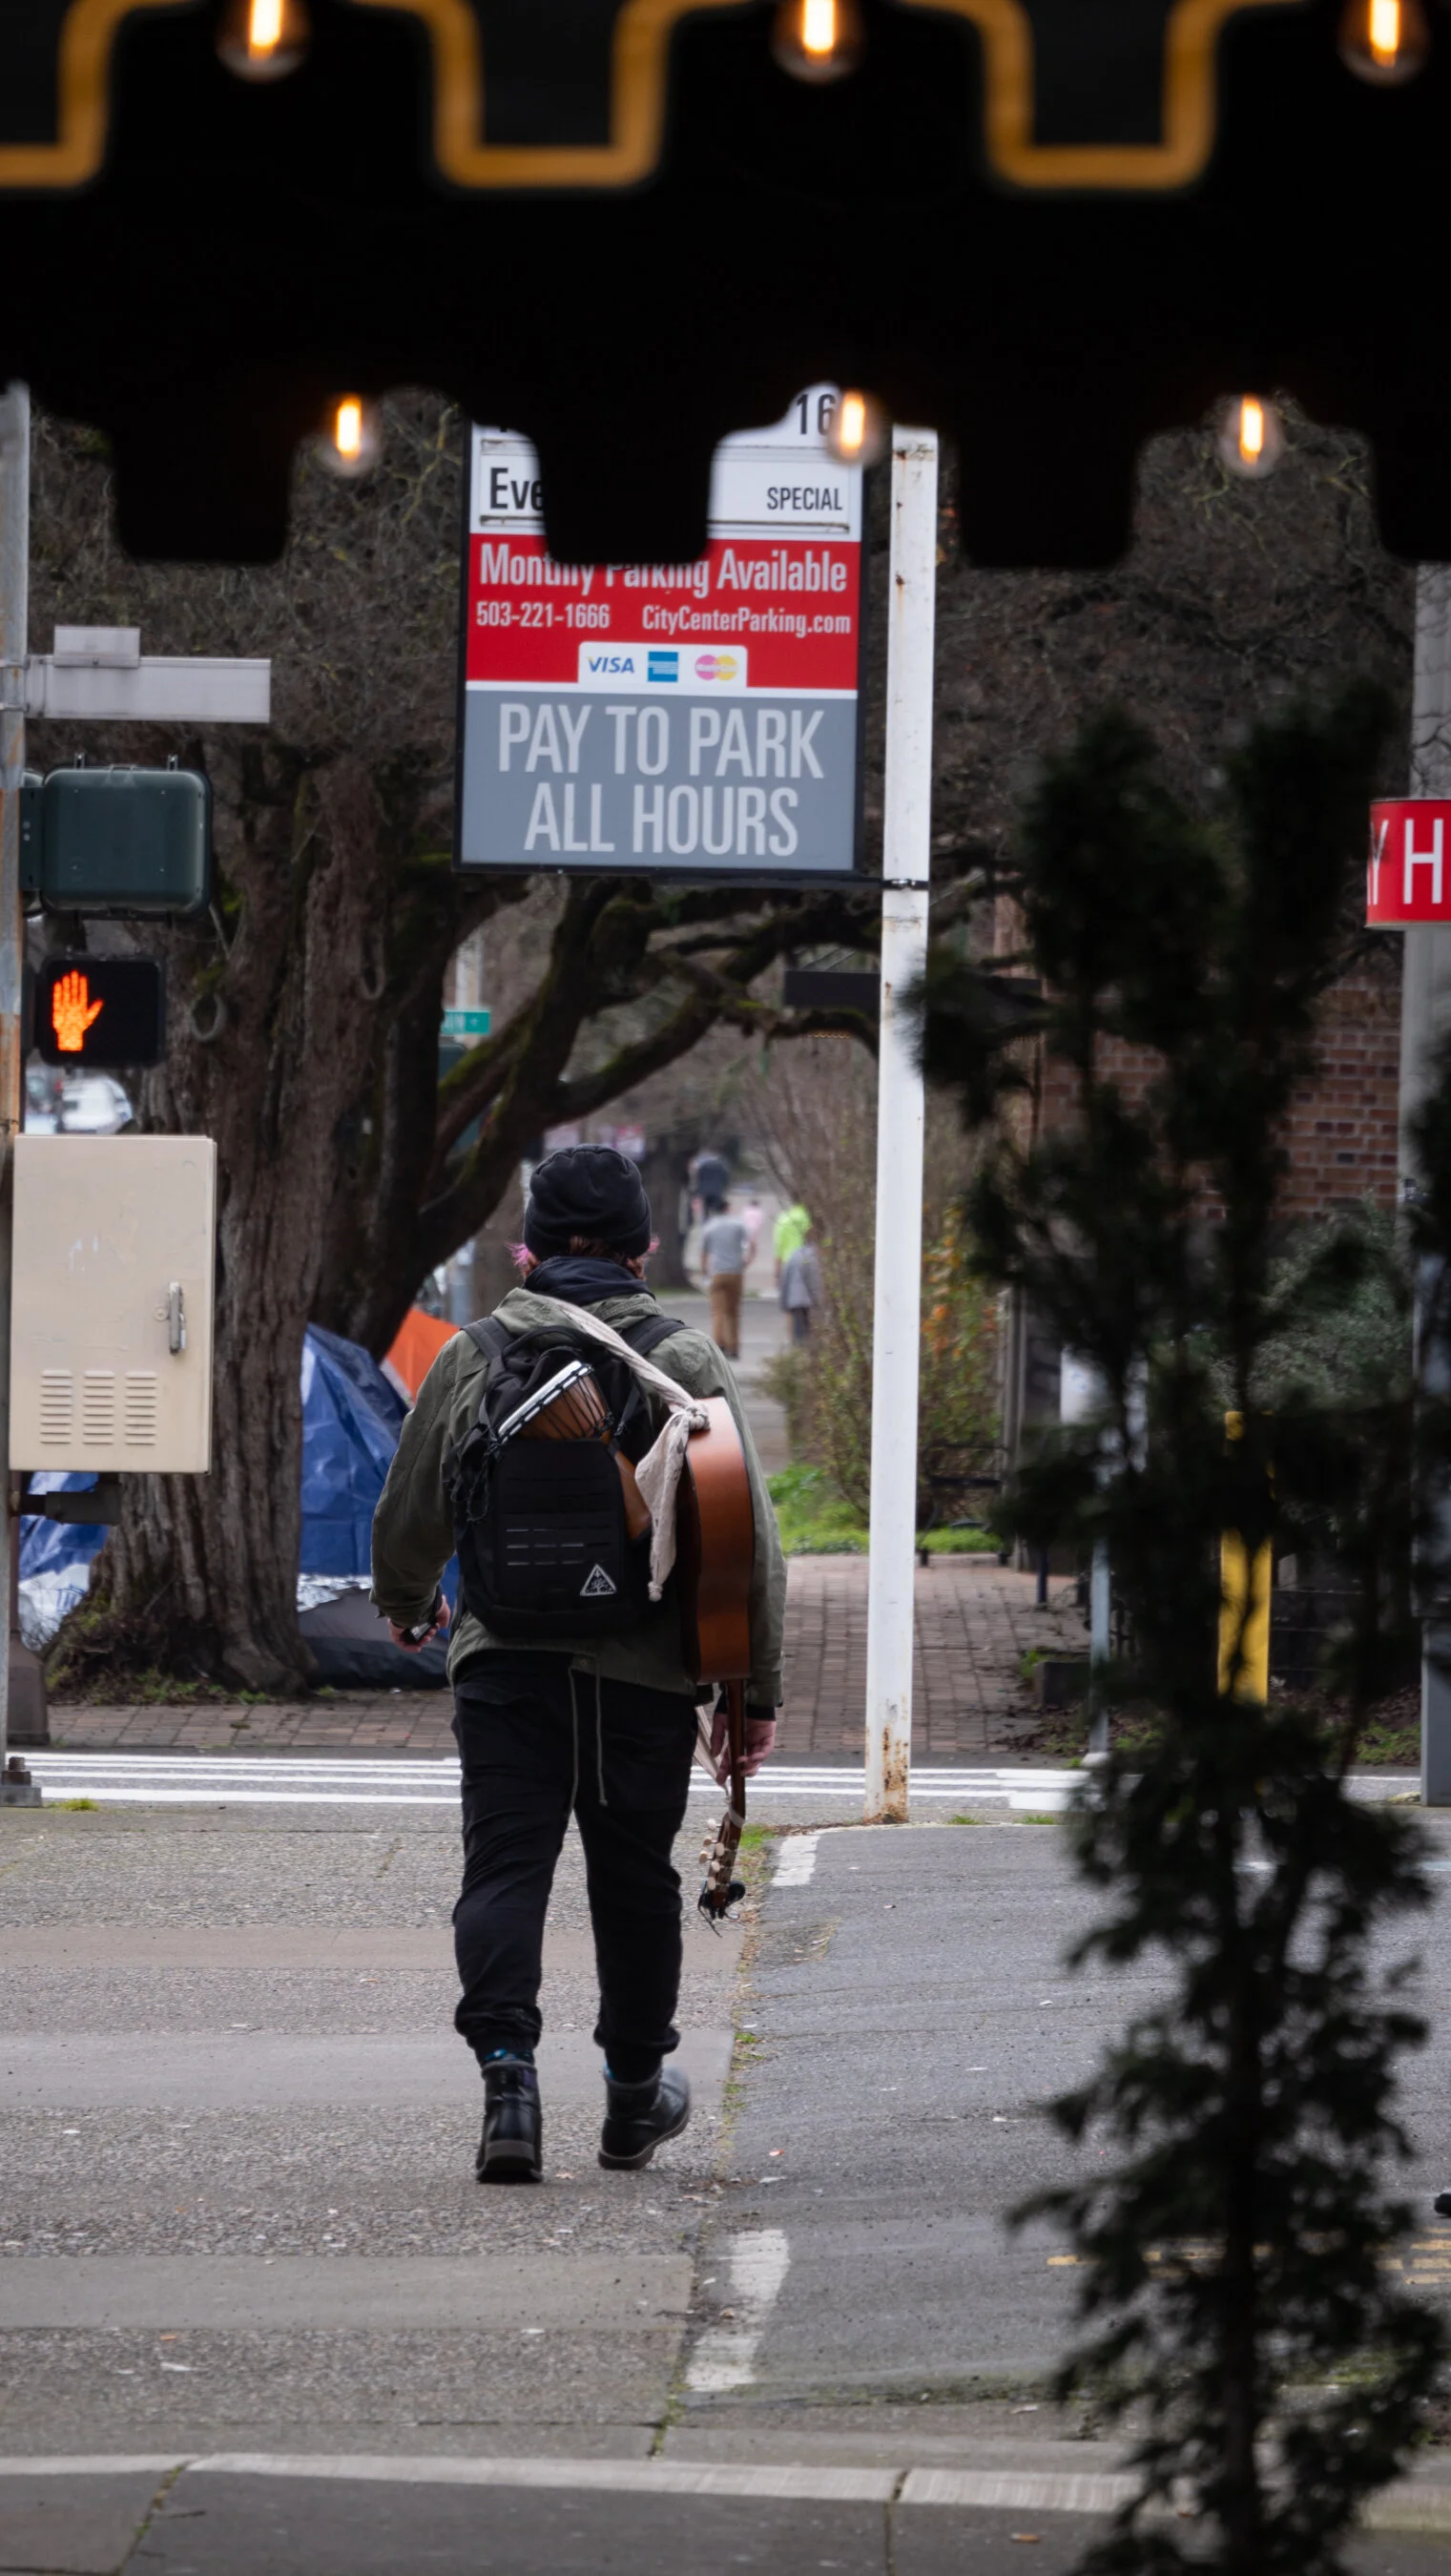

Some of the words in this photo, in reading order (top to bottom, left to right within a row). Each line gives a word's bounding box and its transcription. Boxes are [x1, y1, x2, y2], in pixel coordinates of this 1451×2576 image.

[767, 487, 843, 510] SPECIAL
[716, 549, 847, 592] Available
[477, 600, 611, 629] 503-221-1666
[642, 605, 851, 637] CityCenterParking.com
[588, 656, 635, 675] VISA
[498, 704, 592, 774] PAY
[605, 707, 669, 776] TO
[689, 709, 825, 779] PARK
[523, 782, 614, 851] ALL
[632, 785, 798, 856] HOURS
